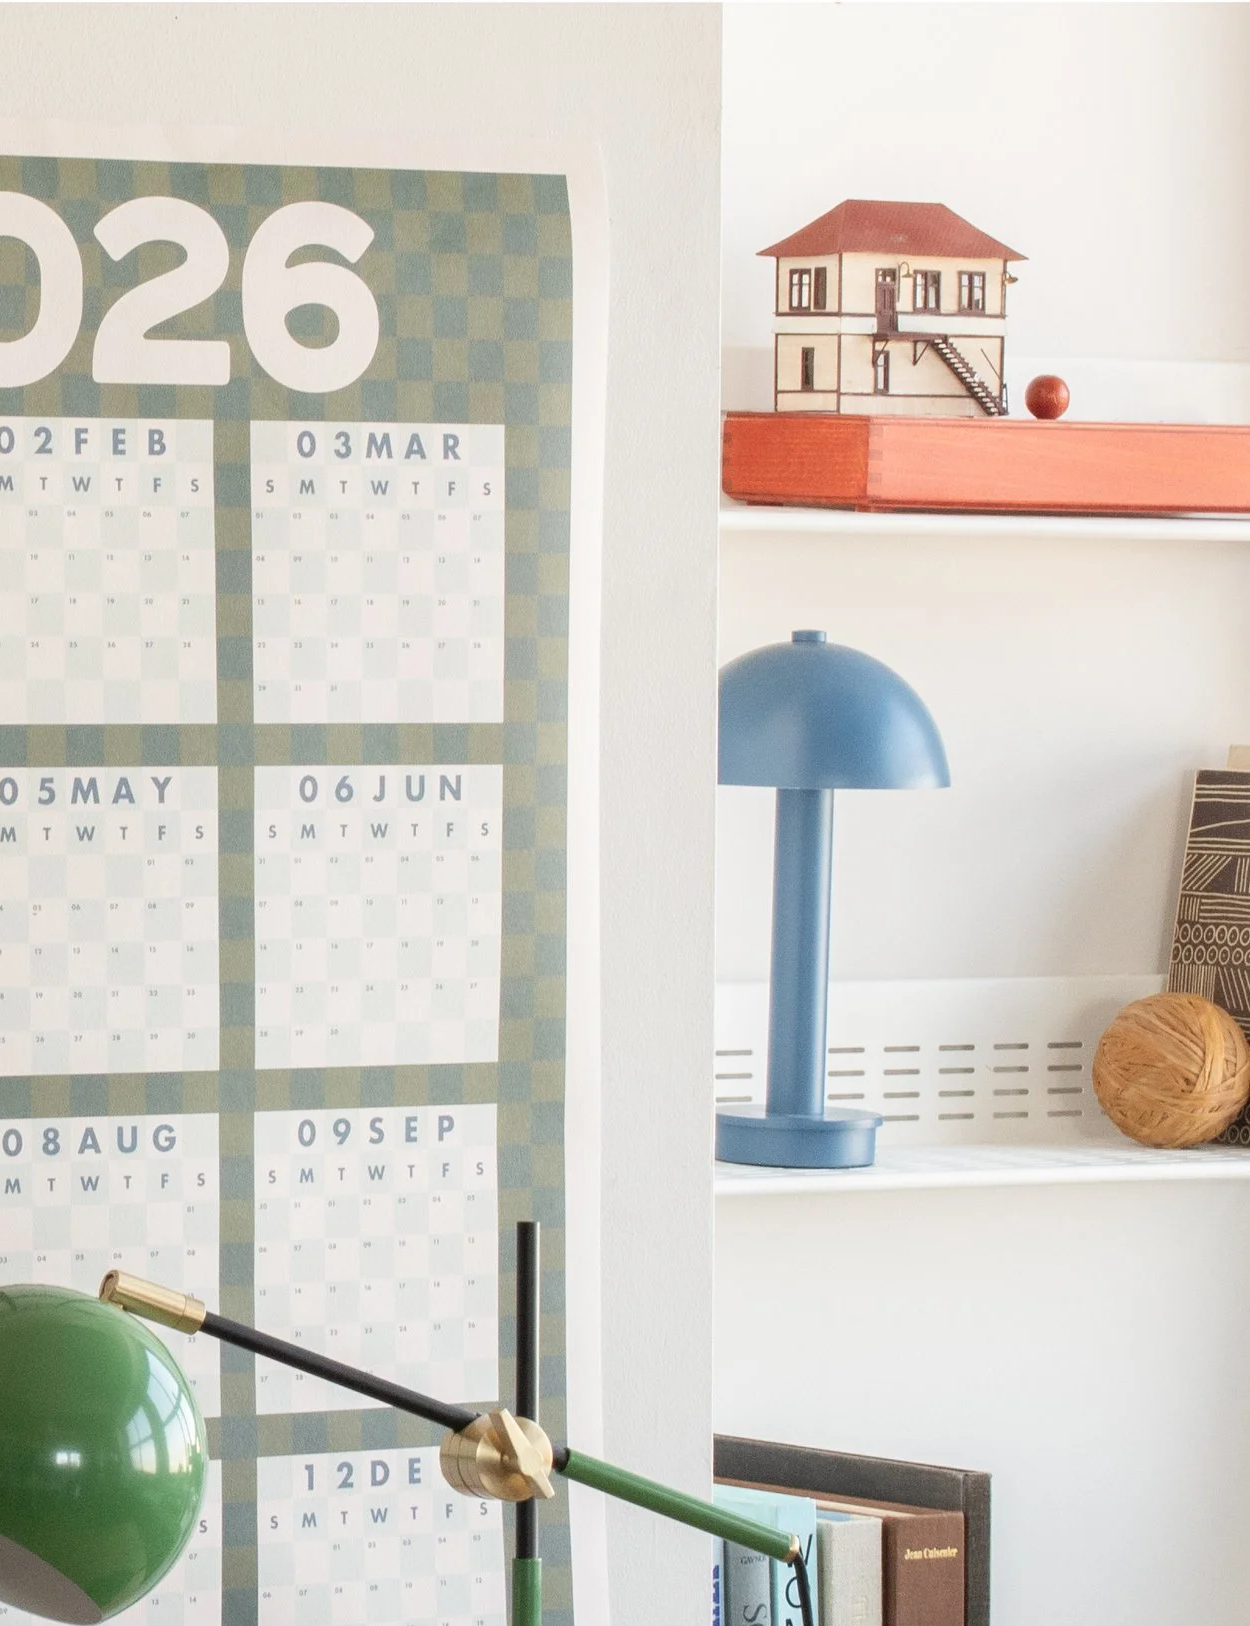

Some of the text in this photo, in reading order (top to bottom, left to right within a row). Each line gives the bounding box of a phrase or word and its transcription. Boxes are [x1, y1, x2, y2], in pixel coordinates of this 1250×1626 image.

[38, 476, 49, 491] T
[71, 475, 92, 493] W
[114, 476, 124, 492] T
[152, 476, 162, 494] F
[190, 477, 200, 493] S
[265, 478, 492, 497] S M T W T F S
[0, 825, 18, 844] M
[42, 826, 52, 842] T
[75, 824, 96, 843] W
[119, 825, 129, 841] T
[157, 824, 167, 841] F
[194, 824, 205, 840] S
[268, 821, 490, 840] S M T W T F S
[268, 1161, 485, 1185] S M T W T F S
[3, 1177, 23, 1195] M
[46, 1177, 57, 1193] T
[79, 1174, 101, 1193] W
[122, 1175, 133, 1190] T
[160, 1172, 170, 1190] F
[196, 1172, 206, 1188] S
[270, 1502, 488, 1530] S M T W T F S
[199, 1519, 209, 1533] S
